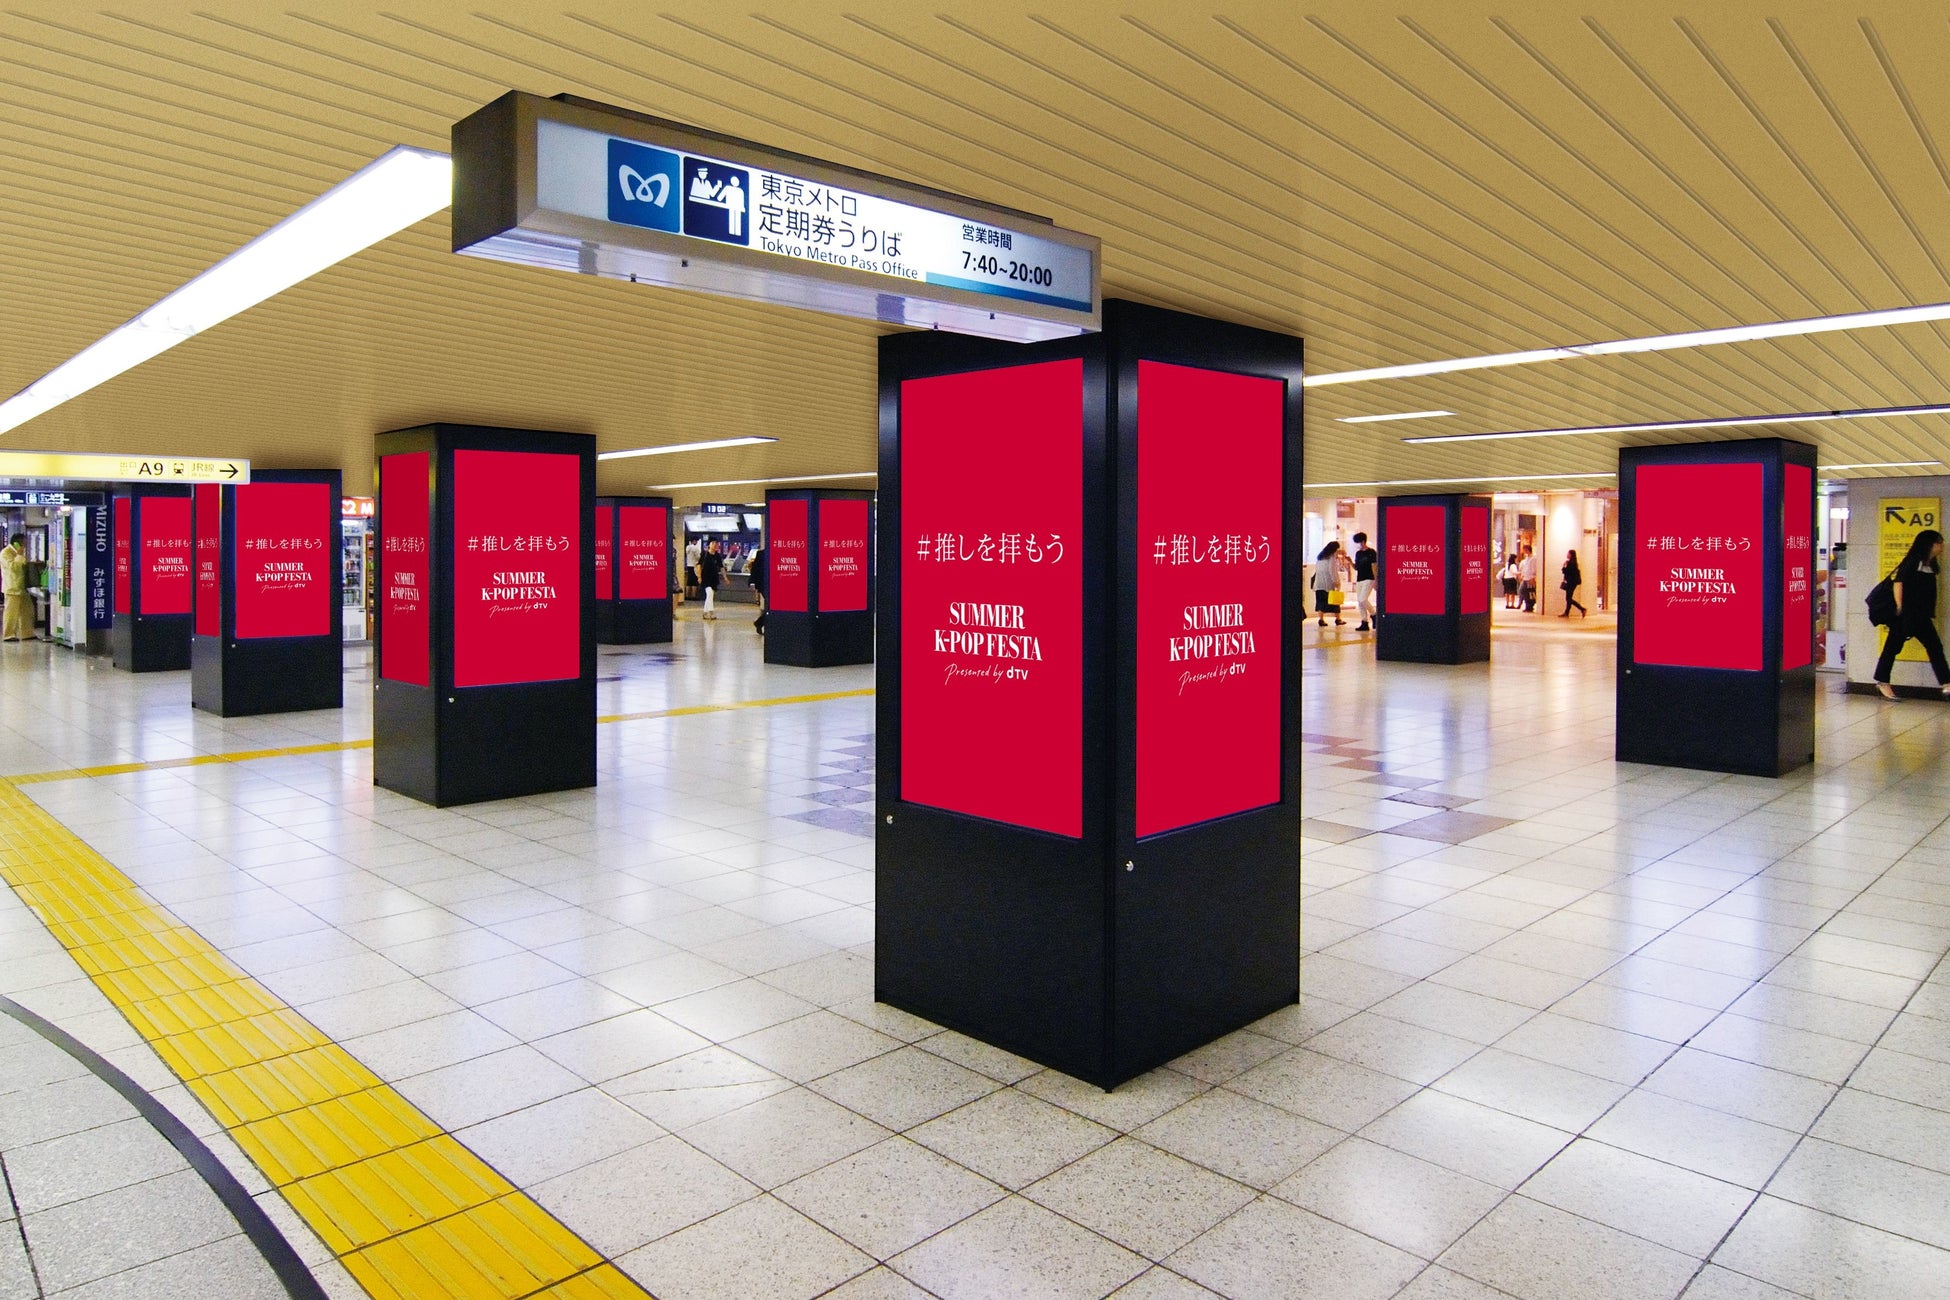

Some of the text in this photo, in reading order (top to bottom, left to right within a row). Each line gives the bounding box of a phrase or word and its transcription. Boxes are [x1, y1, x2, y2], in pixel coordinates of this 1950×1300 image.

[760, 174, 857, 217] 東京メトロ
[758, 203, 903, 258] 定期券うりば
[962, 223, 1012, 251] 営業時間
[760, 236, 918, 279] Tokyo Metro Pass Office
[962, 250, 1053, 287] 7:40~20:00
[138, 462, 164, 476] A9
[1909, 512, 1935, 527] A9
[245, 538, 323, 550] #推しを拝もう
[467, 535, 570, 552] #推しを拝もう
[916, 532, 1065, 564] #推しを拝もう
[1153, 533, 1271, 566] #推しを拝もう
[1646, 536, 1751, 551] #推しを拝もう
[255, 572, 313, 582] K-POP FESTA
[264, 562, 304, 572] SUMMER
[492, 571, 545, 585] SUMMER
[1670, 567, 1724, 581] SUMMER
[481, 586, 557, 601] K-POP FESTA
[1659, 580, 1736, 594] K-POP FESTA
[949, 601, 1026, 630] SUMMER
[1183, 603, 1244, 631] SUMMER
[934, 629, 1043, 661] K-POP FESTA
[1169, 631, 1256, 662] K-POP FESTA
[944, 663, 992, 685] Presented
[1006, 666, 1029, 680] dTV
[1178, 665, 1219, 696] Presented
[1229, 662, 1246, 675] dTV
